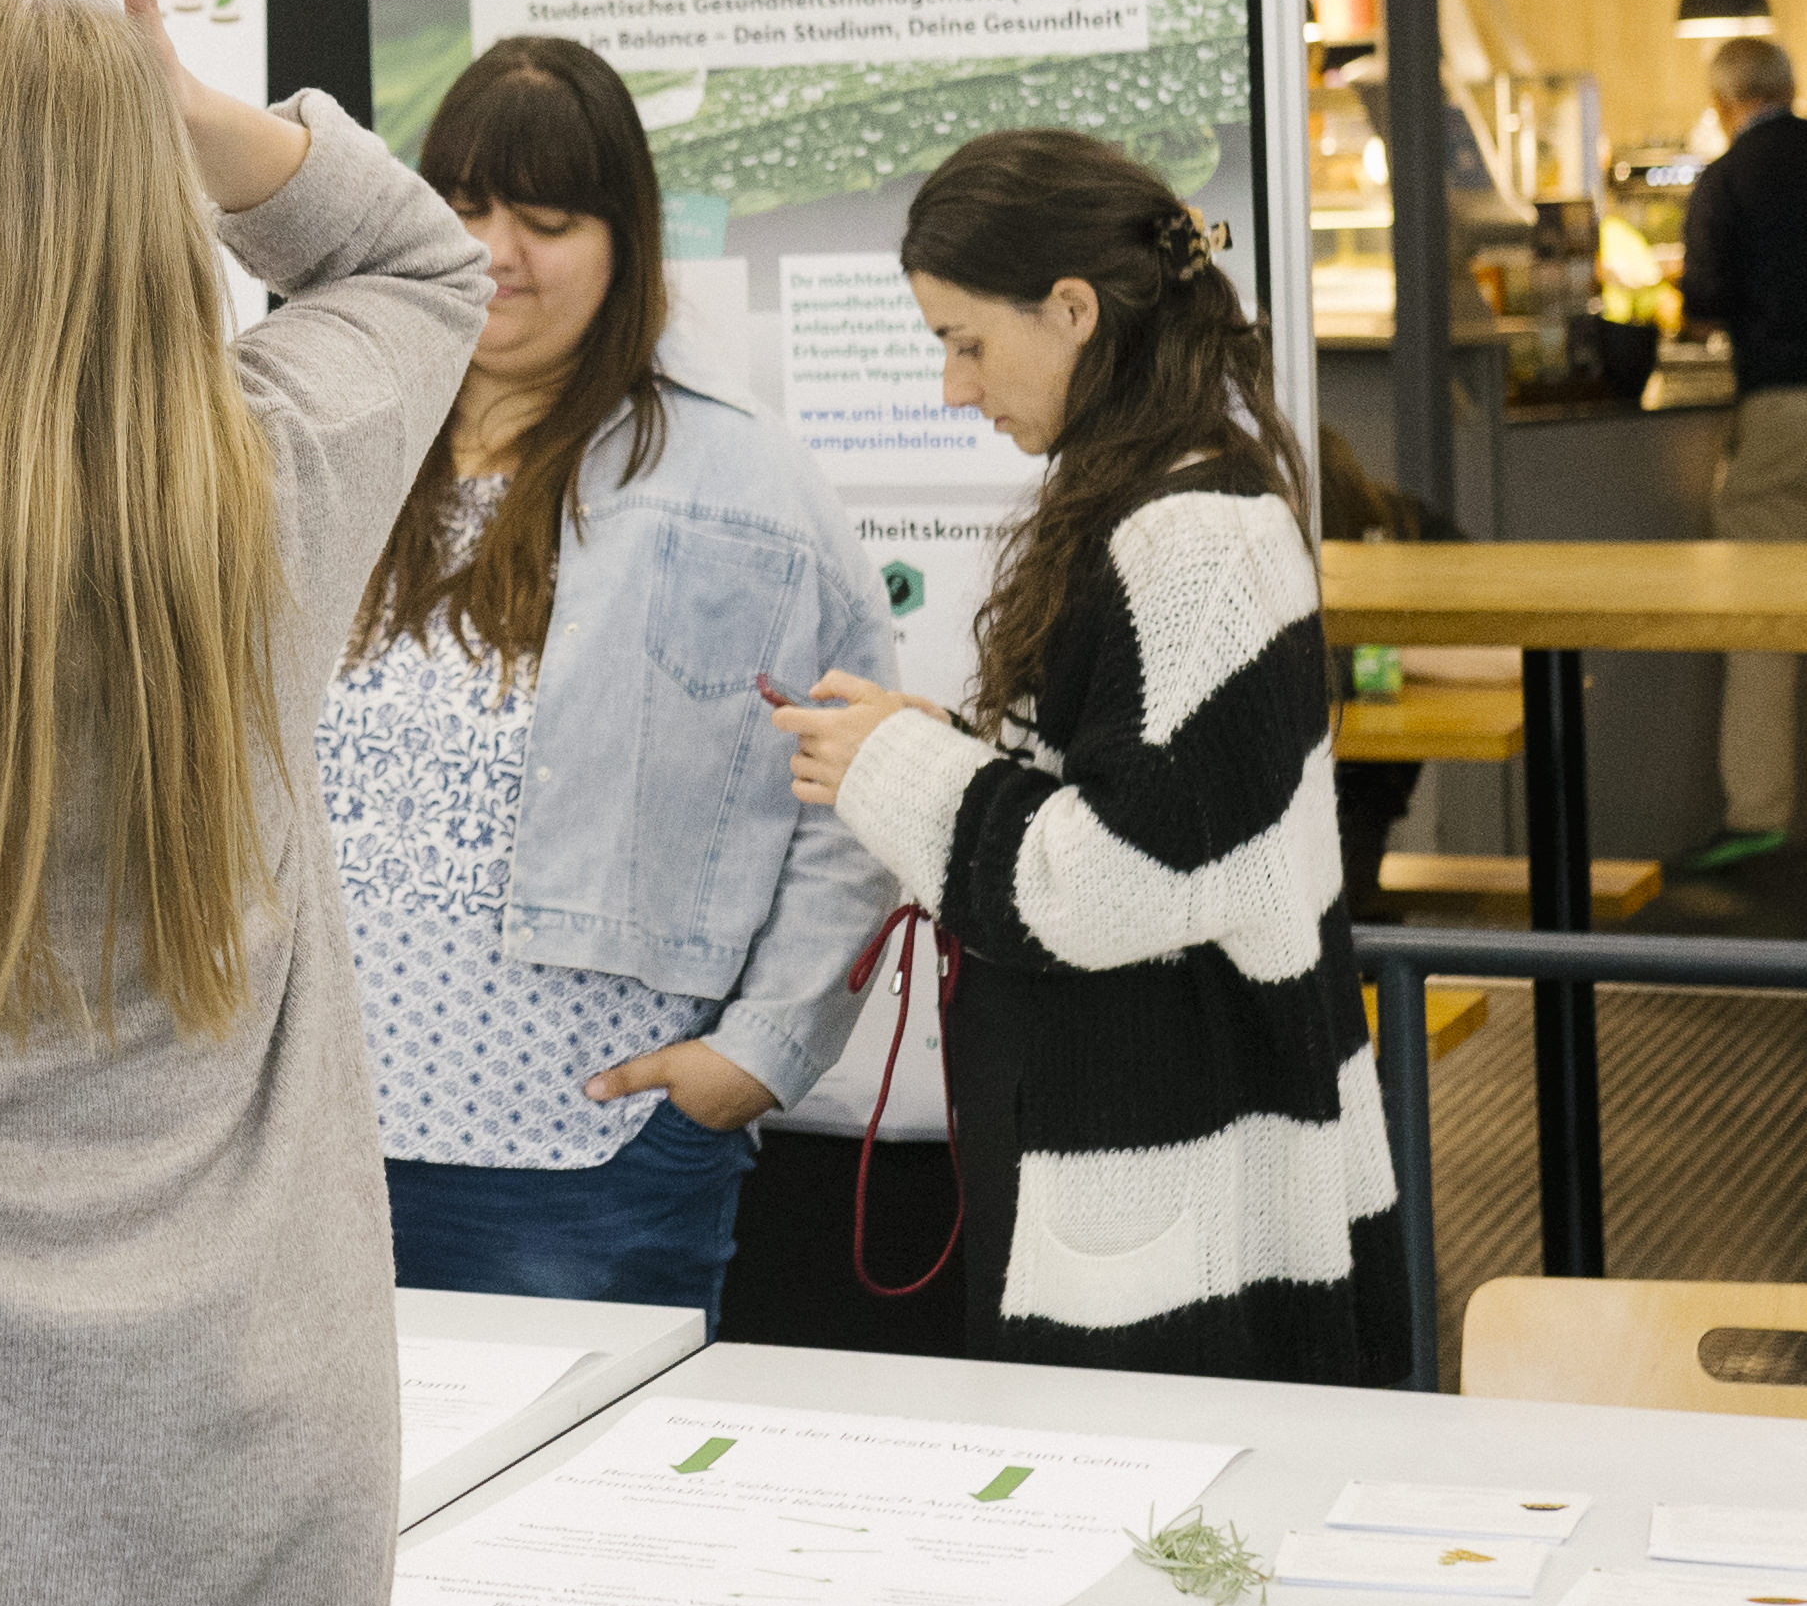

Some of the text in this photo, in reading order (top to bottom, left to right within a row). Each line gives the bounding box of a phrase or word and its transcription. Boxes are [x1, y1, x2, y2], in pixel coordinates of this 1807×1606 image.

[618, 28, 707, 50] Balance
[733, 24, 786, 45] Dein
[794, 15, 901, 42] Studium,
[908, 16, 976, 37] Deine
[791, 295, 916, 314] gesundheitsfö
[801, 430, 977, 452] ampusinbalance
[664, 1415, 755, 1432] Riechen
[950, 1440, 1006, 1458] Weg
[1010, 1449, 1065, 1463] zum
